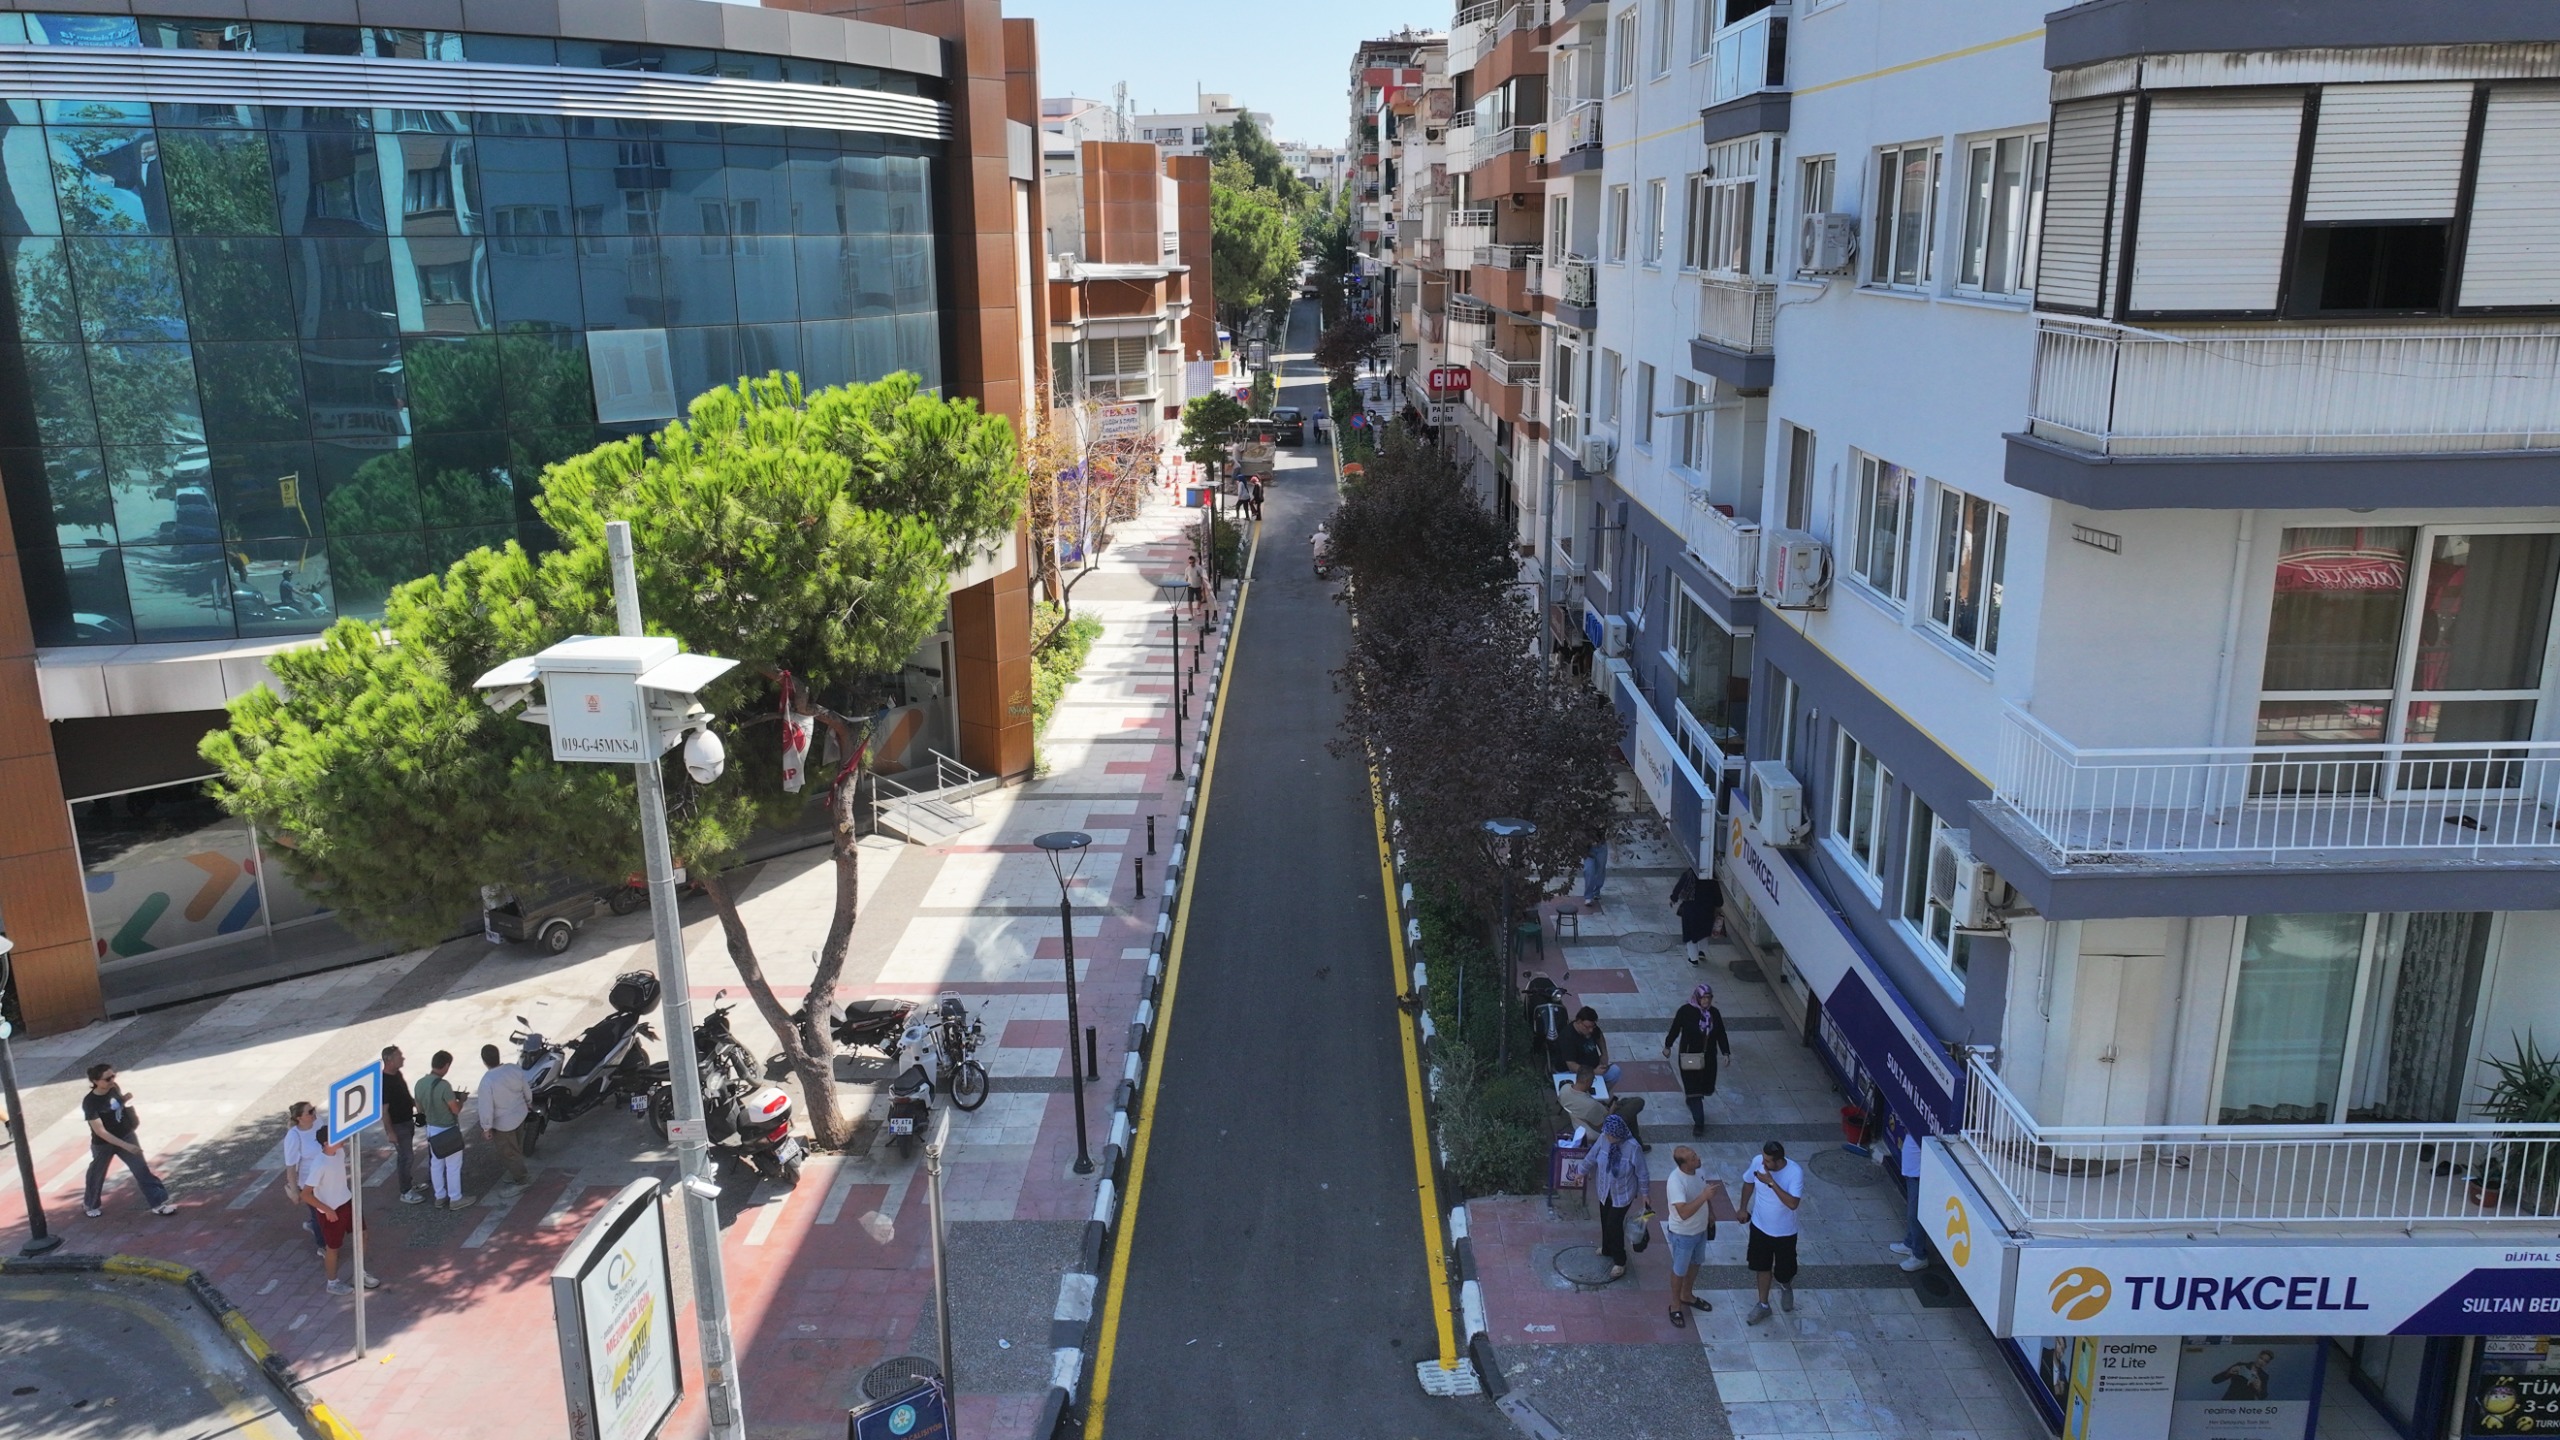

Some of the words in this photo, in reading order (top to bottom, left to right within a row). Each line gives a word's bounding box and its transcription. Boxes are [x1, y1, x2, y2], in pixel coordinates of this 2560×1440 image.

[1433, 369, 1468, 387] BİM
[1431, 415, 1454, 423] GİİM
[1743, 837, 1780, 906] TURKCELL
[1886, 1051, 1914, 1101] SULTAN
[344, 1084, 367, 1124] D
[2504, 1251, 2550, 1262] DİJİTAL
[2124, 1275, 2369, 1311] TURKCELL
[2461, 1297, 2525, 1313] SULTAN
[2103, 1342, 2157, 1355] realme
[2102, 1357, 2117, 1369] 12
[2121, 1357, 2147, 1369] Lite
[2238, 1406, 2263, 1415] Note
[2264, 1406, 2278, 1415] 50
[2523, 1399, 2559, 1413] 3-6
